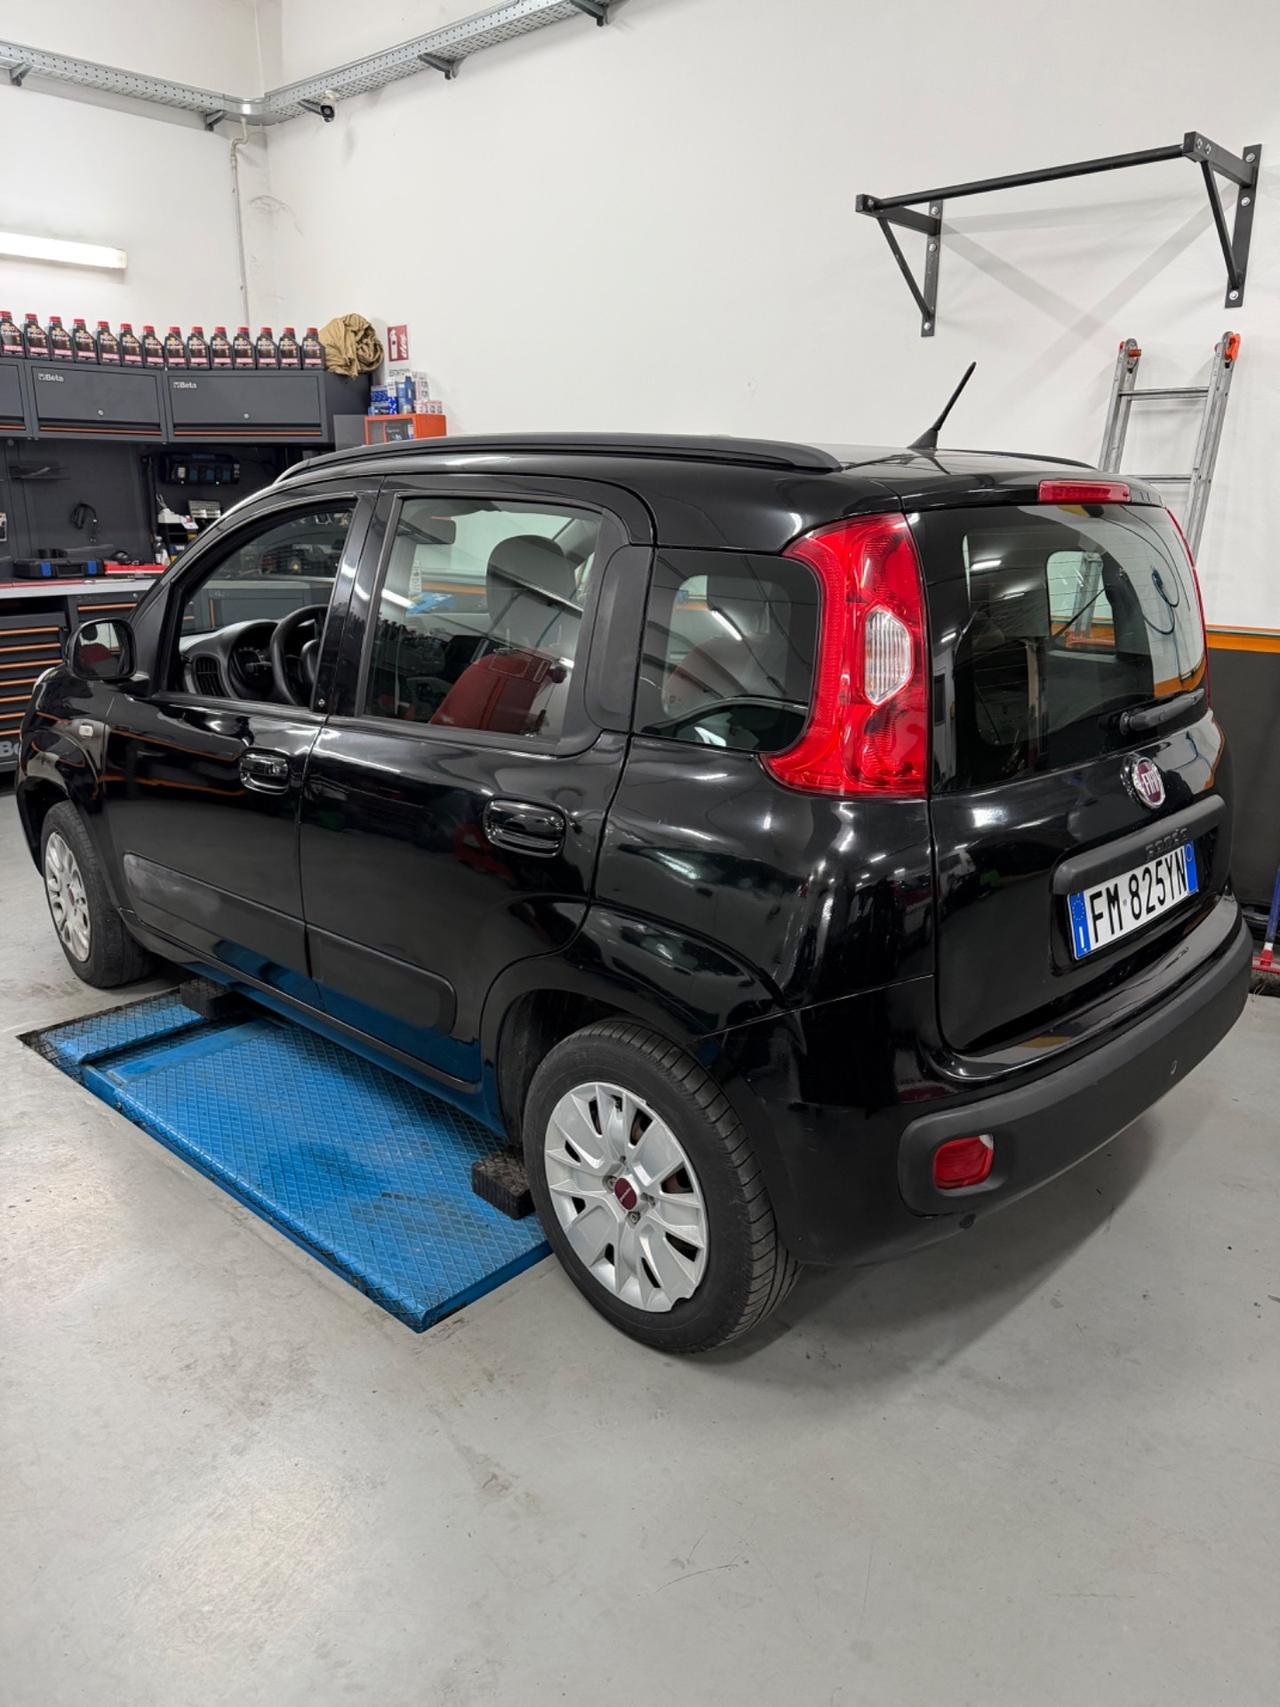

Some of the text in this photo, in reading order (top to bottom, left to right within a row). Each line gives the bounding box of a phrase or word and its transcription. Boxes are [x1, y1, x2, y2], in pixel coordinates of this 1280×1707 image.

[45, 373, 64, 382] Beta
[180, 381, 197, 389] Beta
[1089, 848, 1188, 943] FM 825YN
